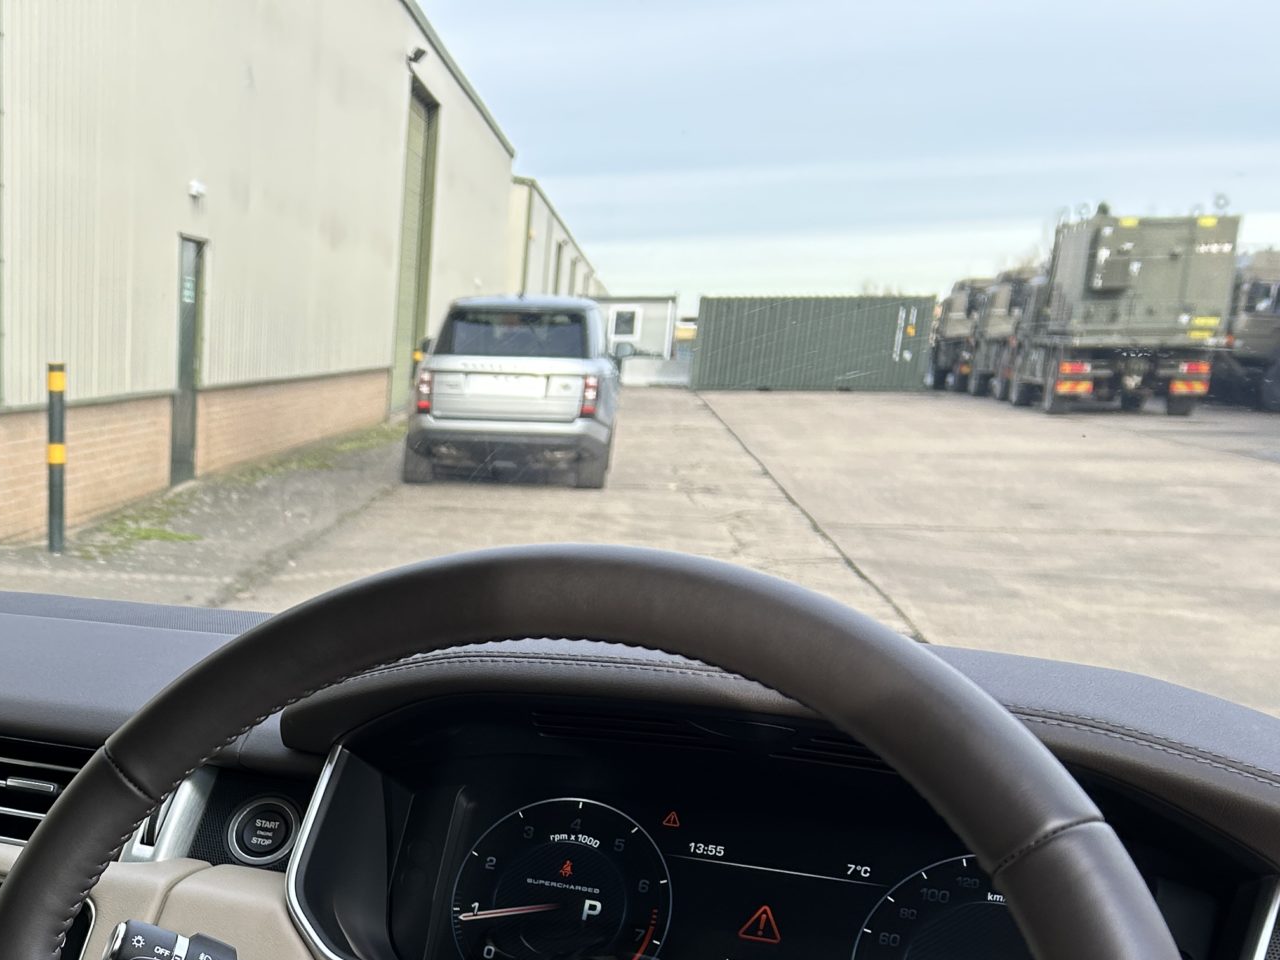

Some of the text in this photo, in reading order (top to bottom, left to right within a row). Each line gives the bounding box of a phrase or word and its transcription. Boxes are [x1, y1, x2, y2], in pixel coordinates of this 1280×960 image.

[255, 818, 280, 829] START
[571, 818, 582, 832] 4
[523, 825, 535, 839] 3
[250, 836, 273, 846] STOP
[549, 833, 569, 843] rpm
[577, 833, 600, 848] 1000
[614, 838, 626, 852] 5
[688, 841, 726, 857] 13:55
[484, 856, 497, 870] 2
[846, 863, 871, 878] 7°C
[526, 877, 601, 895] SUPERCHARGED
[638, 878, 650, 893] 6
[920, 887, 950, 902] 100
[471, 901, 480, 917] 1
[581, 899, 602, 921] P
[899, 907, 918, 920] 80
[634, 928, 646, 942] 7
[878, 931, 901, 947] 60
[153, 945, 172, 957] OFF
[482, 945, 496, 959] 0
